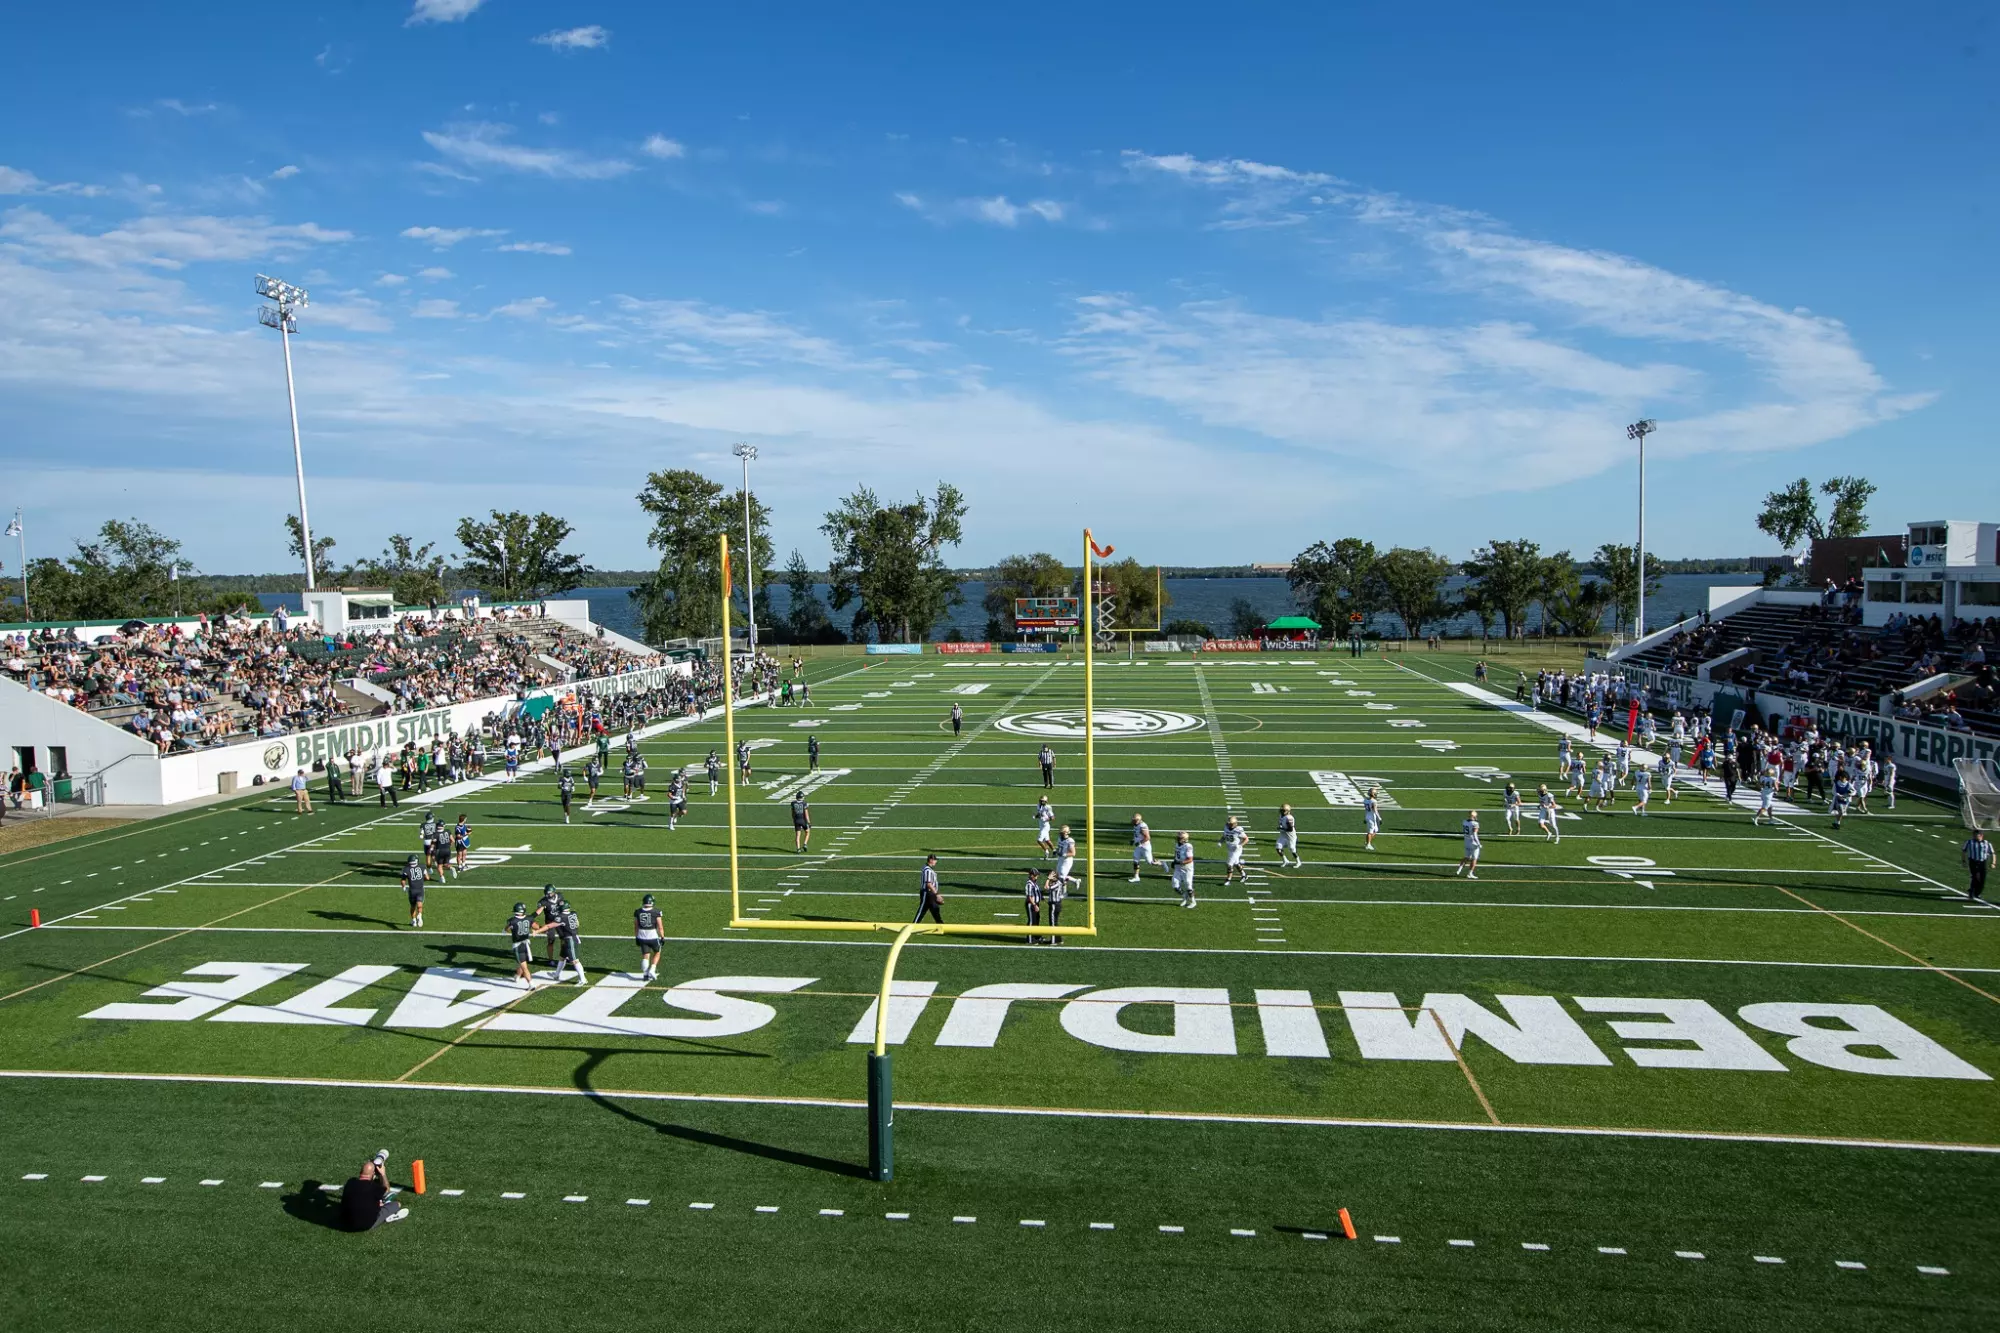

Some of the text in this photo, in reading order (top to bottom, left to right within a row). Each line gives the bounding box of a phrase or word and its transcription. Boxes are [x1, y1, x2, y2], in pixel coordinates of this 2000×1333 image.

[1350, 612, 1363, 622] 25
[1265, 641, 1316, 649] WIDSETH
[621, 667, 674, 693] TERRITORY
[1787, 701, 1810, 716] THIS
[1817, 708, 1895, 753] BEAVER
[296, 709, 452, 766] BEMIDJI STATE
[409, 866, 423, 881] 13
[639, 913, 652, 928] 51
[77, 961, 1996, 1082] BEMIDJI STATE
